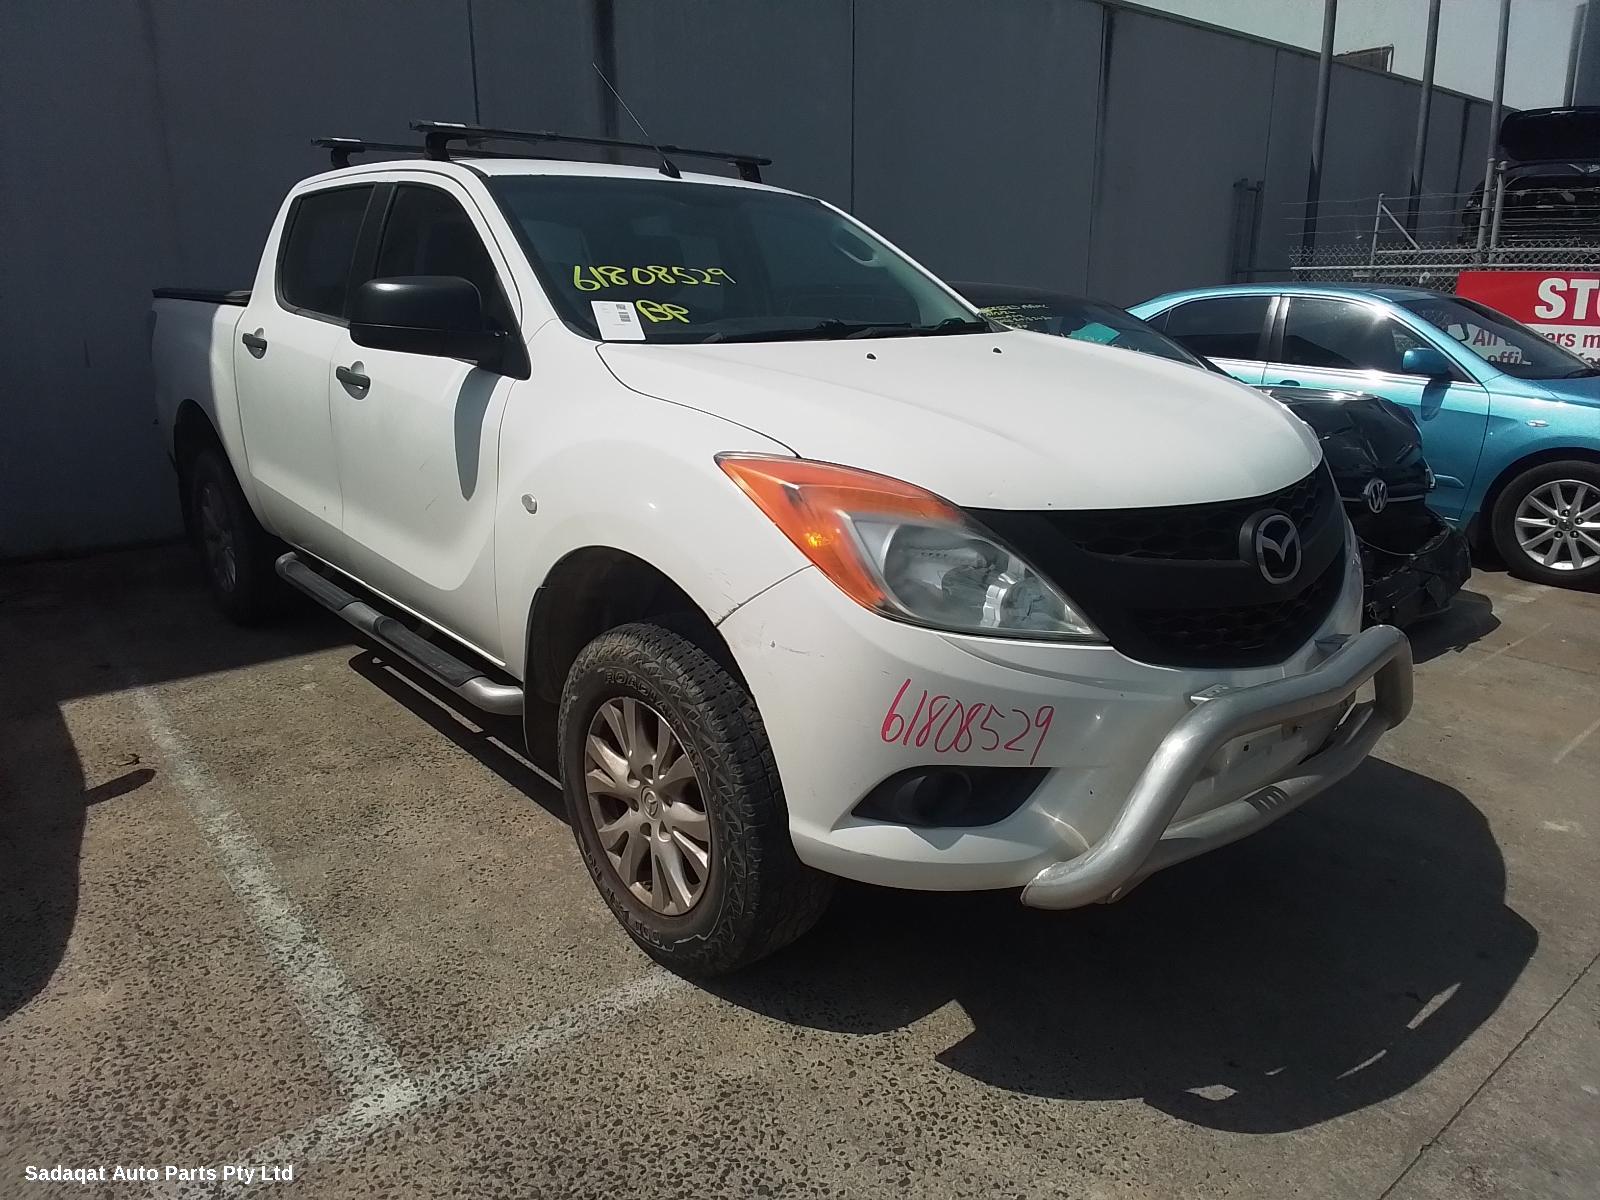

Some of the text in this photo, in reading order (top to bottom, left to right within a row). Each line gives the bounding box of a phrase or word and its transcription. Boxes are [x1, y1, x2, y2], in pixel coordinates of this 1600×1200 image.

[573, 265, 737, 291] 61808529
[1534, 277, 1600, 320] ST
[880, 678, 1055, 766] 61808529
